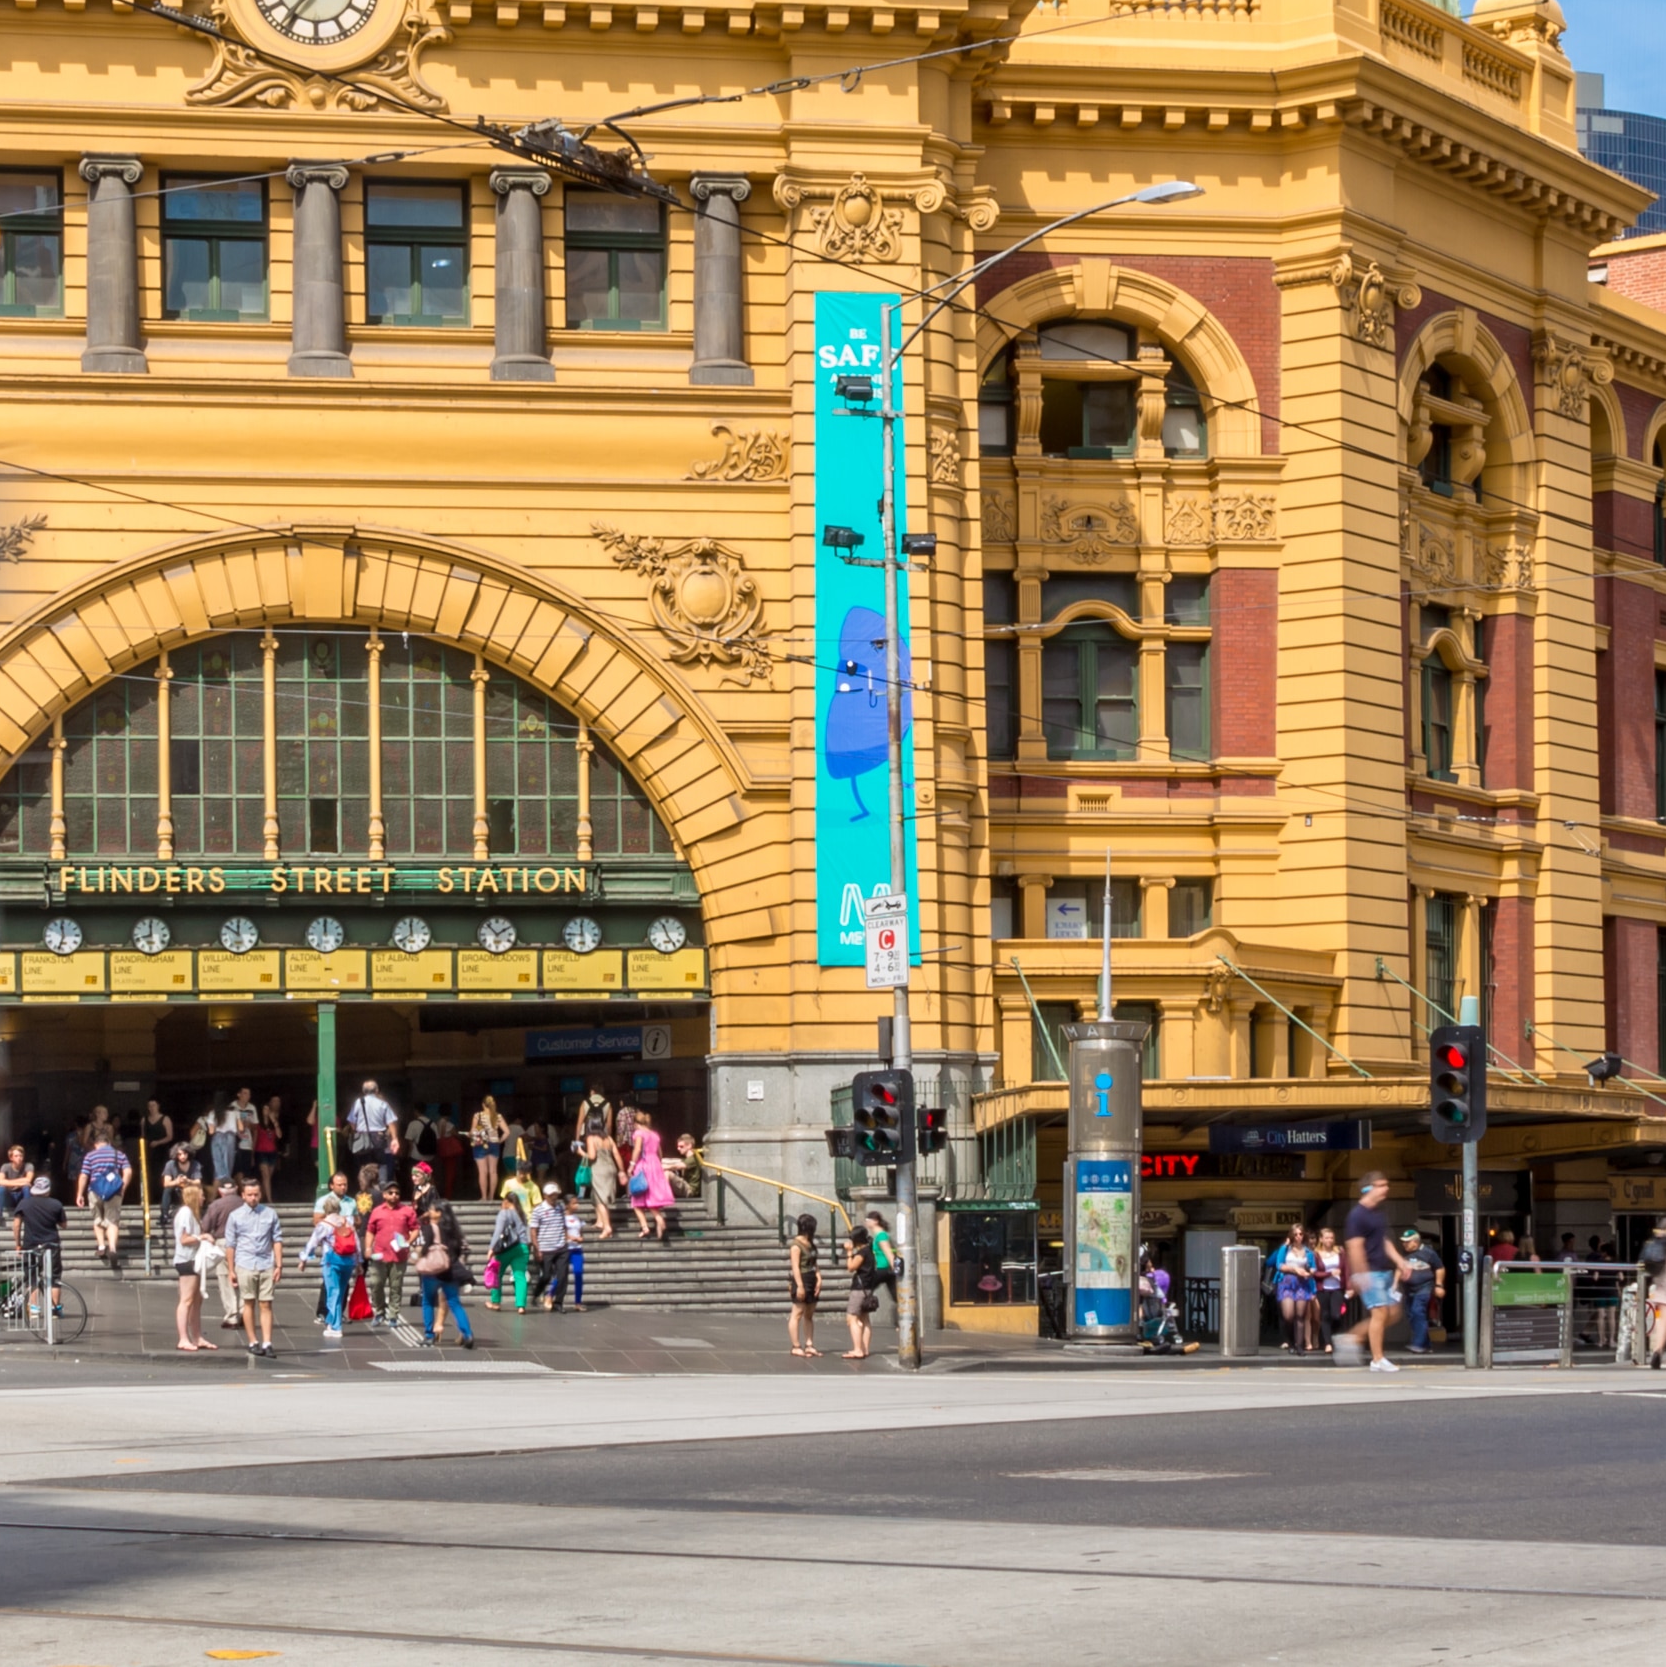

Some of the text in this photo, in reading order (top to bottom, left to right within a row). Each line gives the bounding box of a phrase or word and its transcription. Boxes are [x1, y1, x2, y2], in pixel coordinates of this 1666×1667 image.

[849, 328, 868, 339] BE
[60, 866, 586, 893] FLINDERS STREET STATION
[867, 919, 904, 929] CLEARWAY
[203, 954, 266, 962] WILLIAMSTOWN
[290, 953, 322, 961] ALTONA
[376, 953, 419, 962] ST ALBANS
[462, 953, 530, 962] BROADMEADOWS
[547, 953, 580, 962] UPFIELD
[632, 953, 672, 962] WERRIBEE
[24, 966, 42, 975] LINE
[114, 966, 132, 975] LINE
[202, 965, 220, 973] LINE
[289, 964, 307, 972] LINE
[376, 964, 393, 972] LINE
[462, 964, 479, 973] LINE
[547, 964, 565, 972] LINE
[632, 964, 649, 972] LINE
[537, 1034, 640, 1052] Customer Service
[1141, 1155, 1199, 1176] CITY
